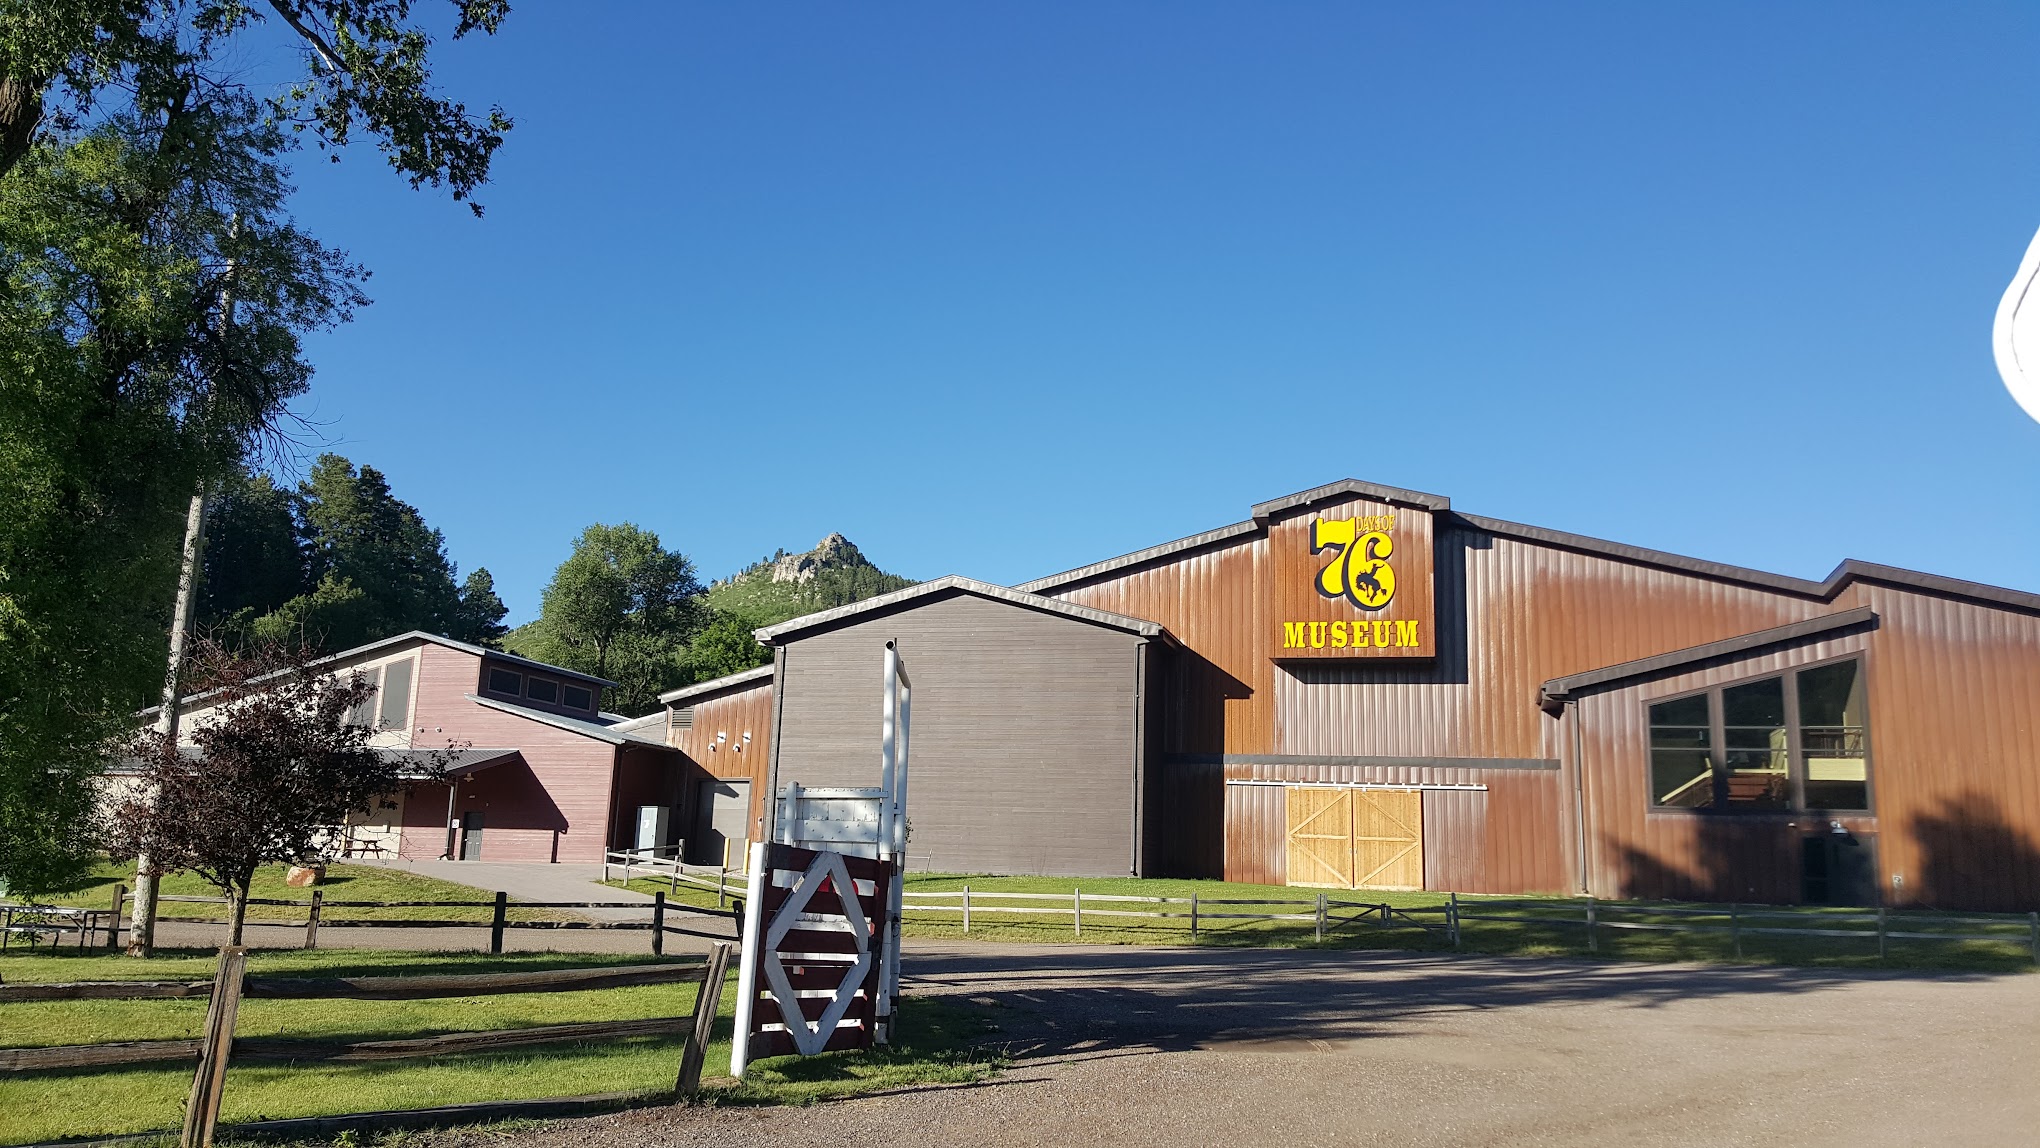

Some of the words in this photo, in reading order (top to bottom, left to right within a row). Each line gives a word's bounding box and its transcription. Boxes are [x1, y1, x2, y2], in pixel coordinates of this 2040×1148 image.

[1356, 515, 1381, 532] DAYS
[1381, 514, 1396, 531] OF
[1311, 517, 1396, 610] 76
[1283, 620, 1419, 649] MUSEUM
